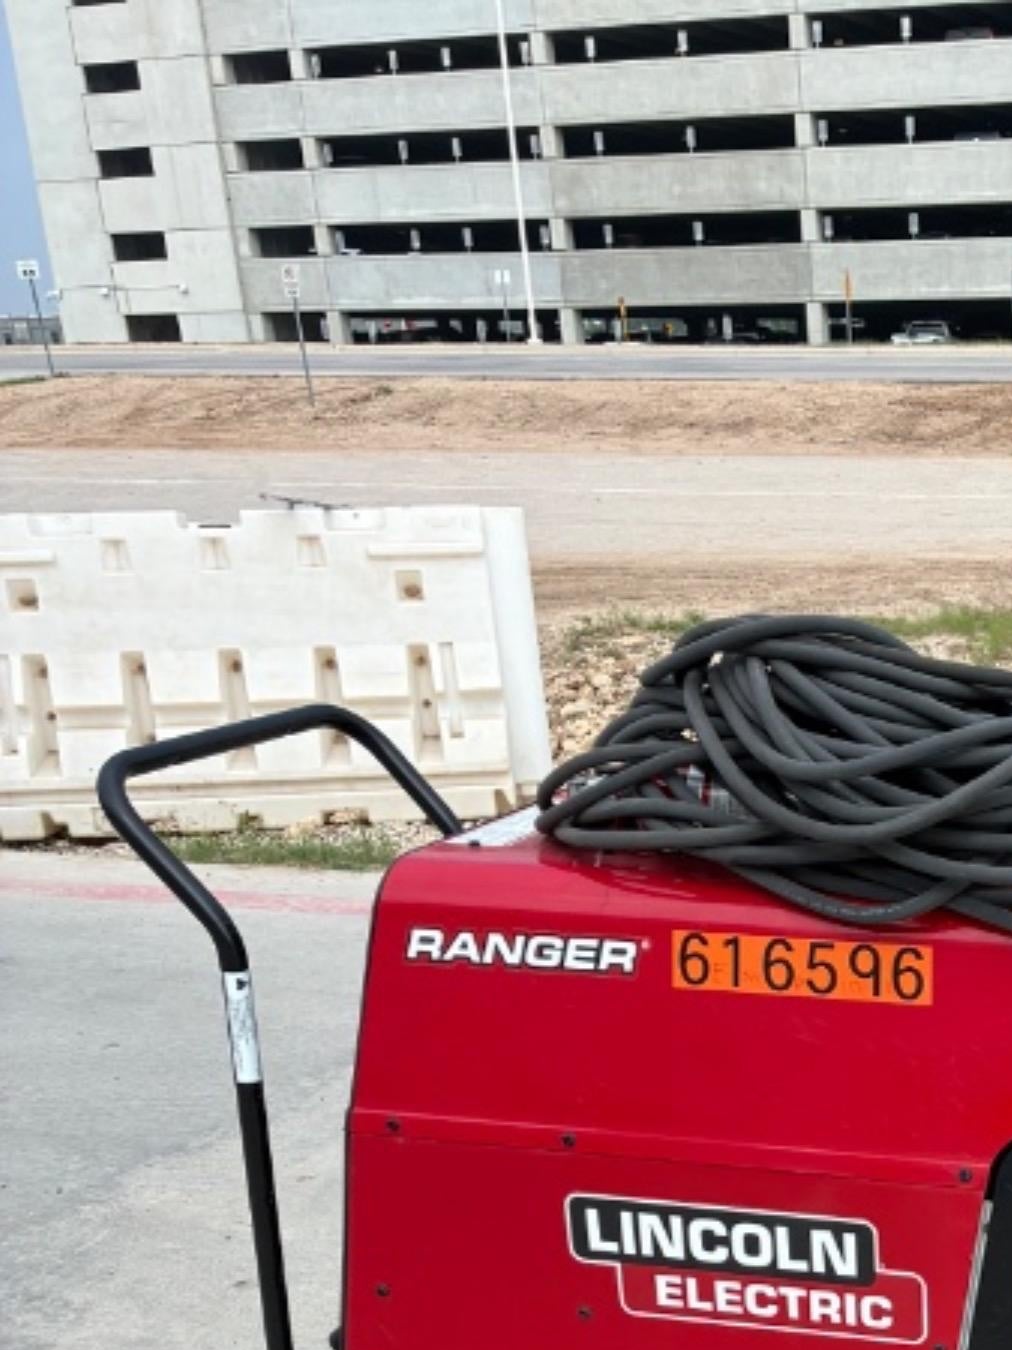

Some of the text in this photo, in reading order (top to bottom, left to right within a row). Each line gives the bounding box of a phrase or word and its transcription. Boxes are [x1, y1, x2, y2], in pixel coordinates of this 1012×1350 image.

[406, 928, 637, 973] RANGER
[679, 932, 925, 1000] 616596
[584, 1208, 859, 1278] LINCOLN
[653, 1273, 894, 1330] ELECTRIC
